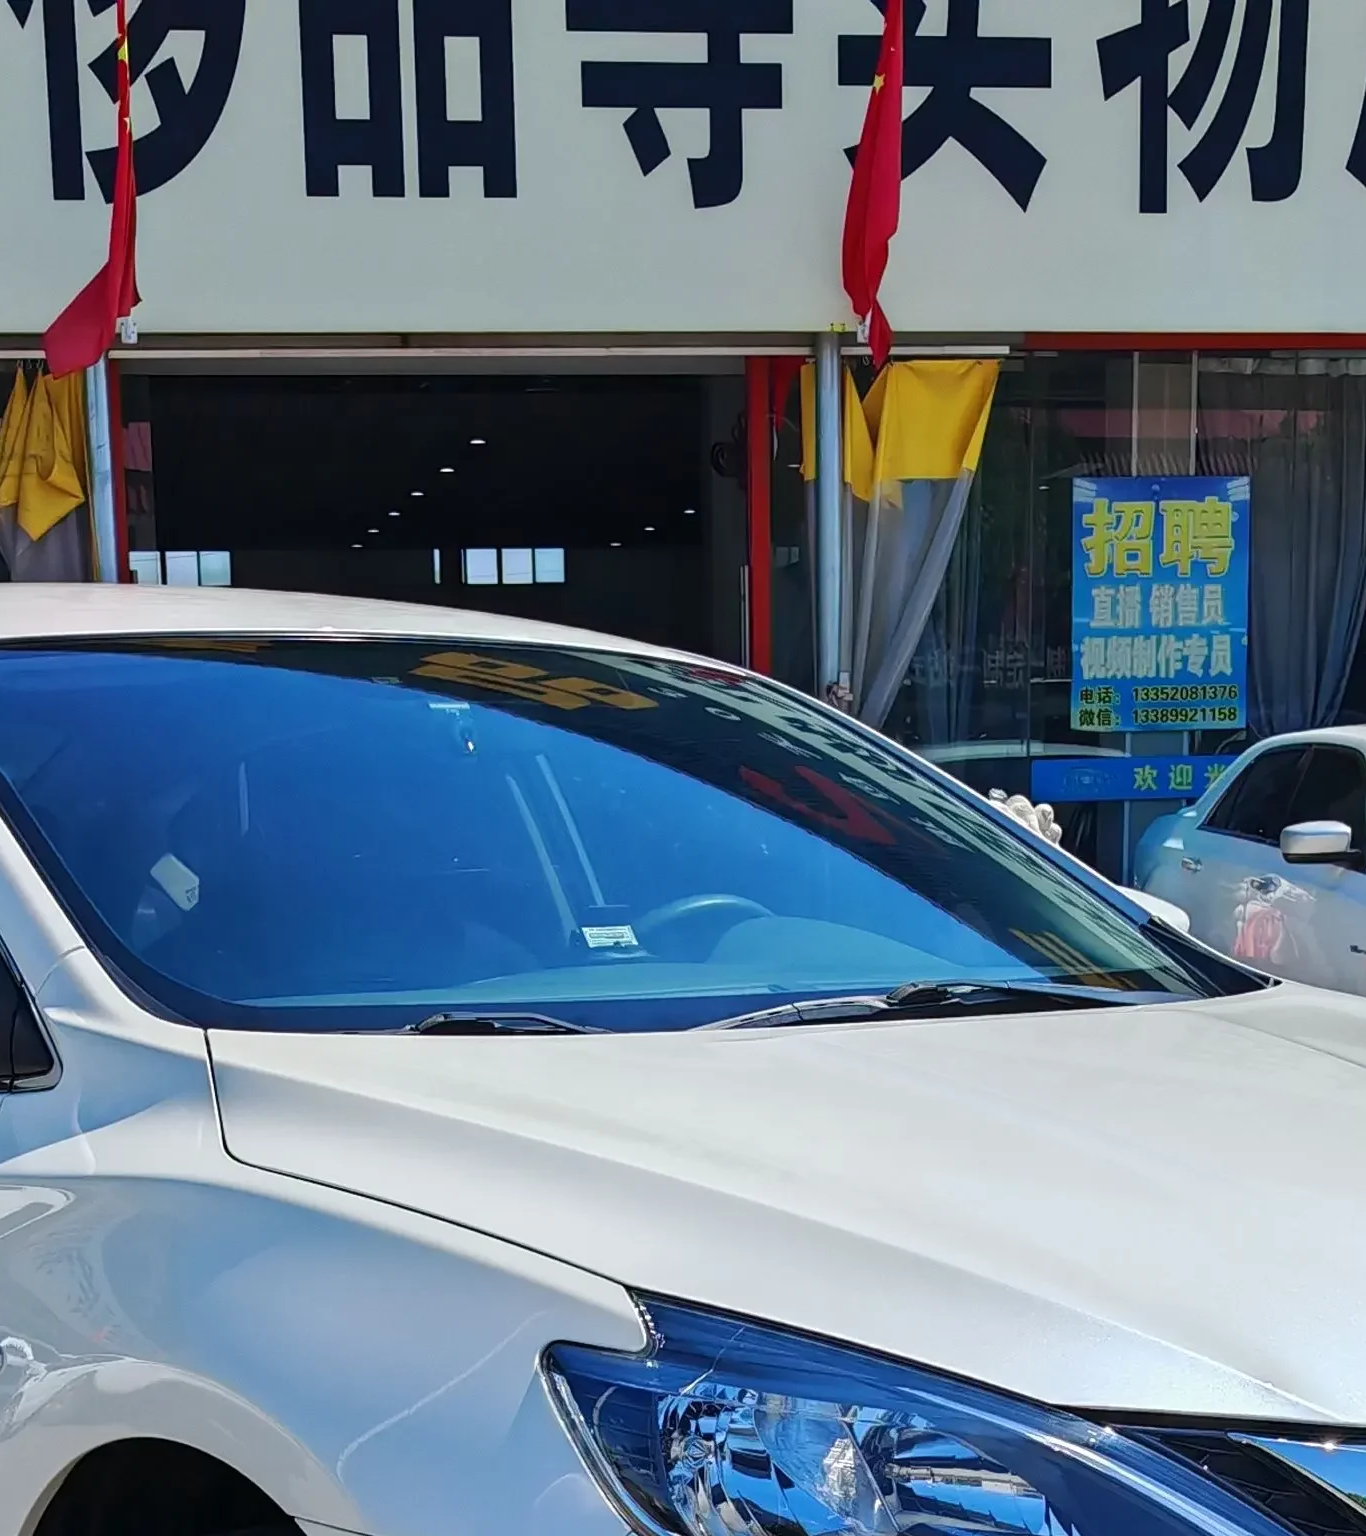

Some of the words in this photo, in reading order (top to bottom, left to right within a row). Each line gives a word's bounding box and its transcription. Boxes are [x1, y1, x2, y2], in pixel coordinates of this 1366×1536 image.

[1081, 496, 1235, 577] 招聘
[1090, 585, 1142, 629] 直播
[1150, 583, 1225, 628] 销售员
[1080, 633, 1233, 680] 视频制作专员
[1133, 685, 1237, 702] 13352081376
[1133, 706, 1237, 724] 13389921158
